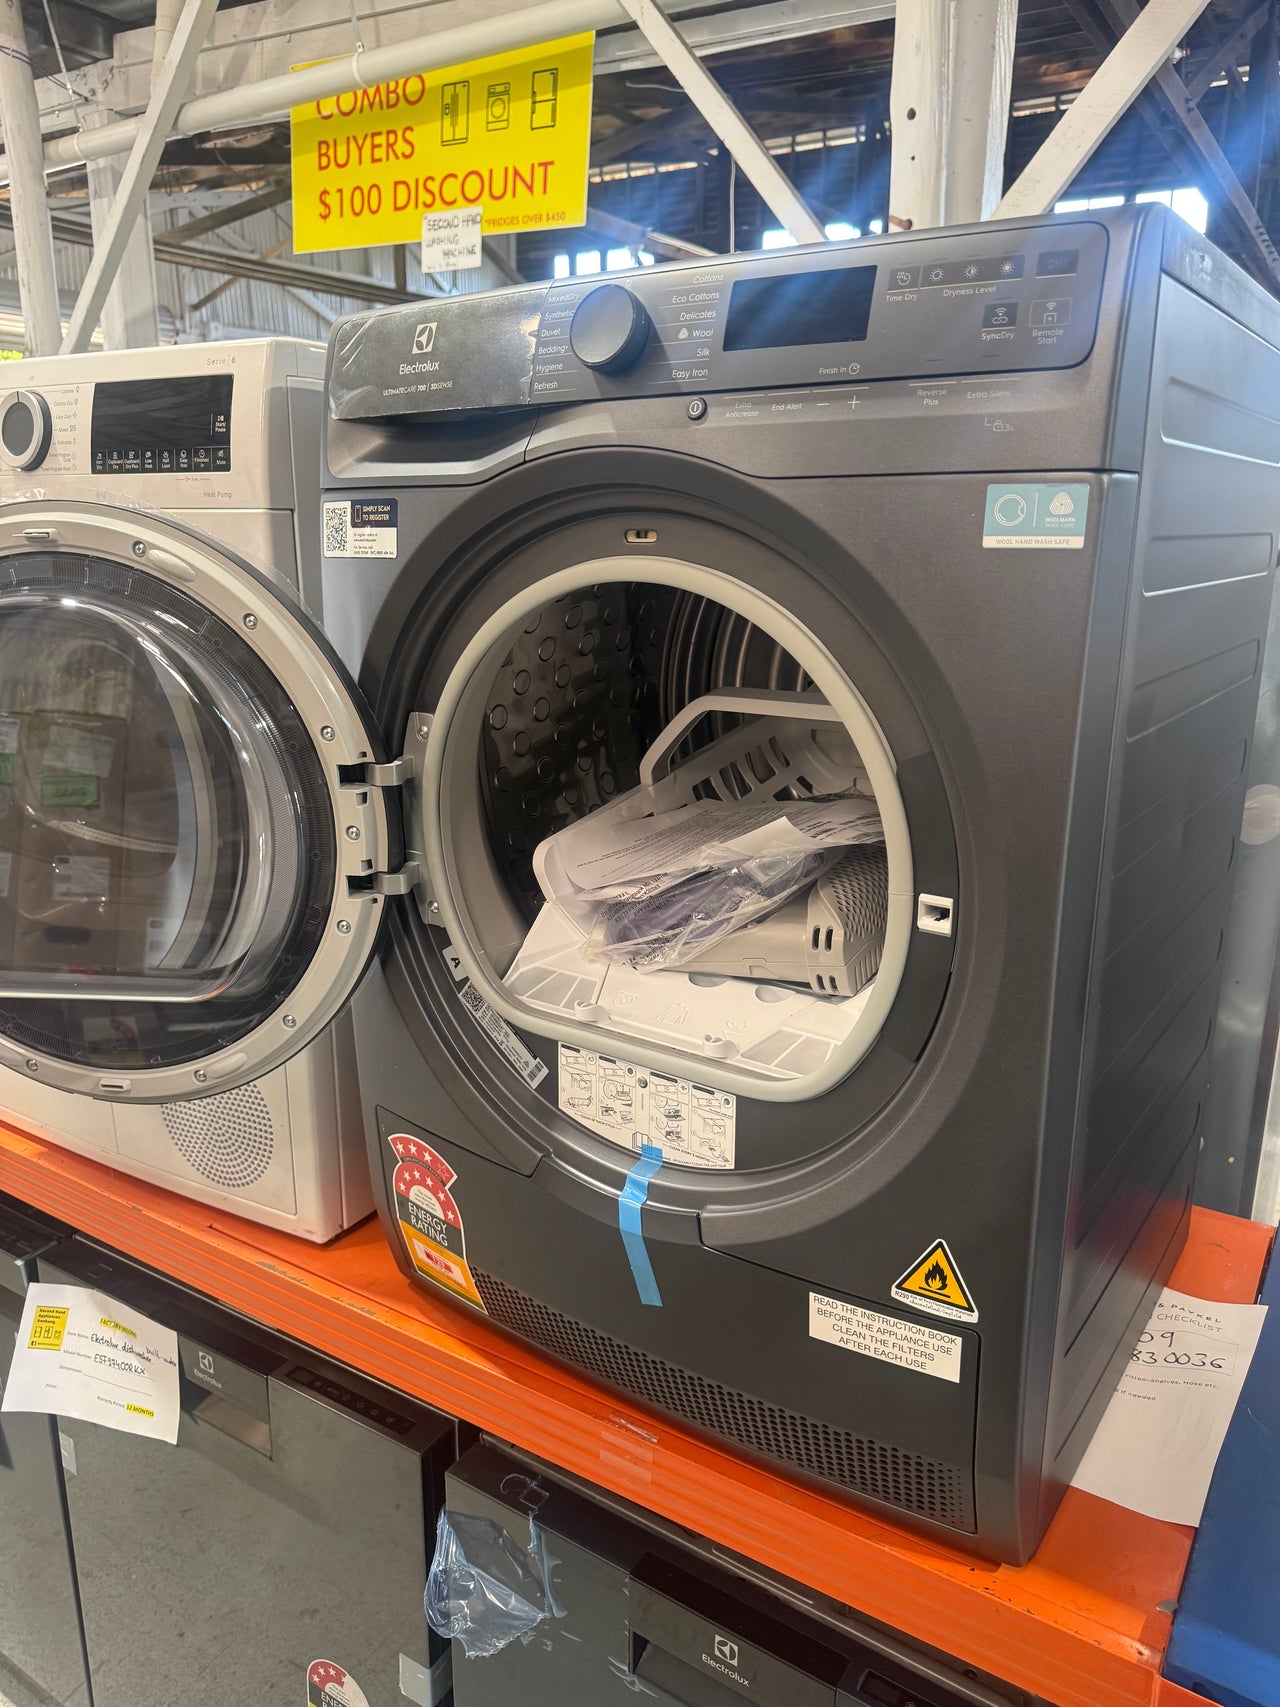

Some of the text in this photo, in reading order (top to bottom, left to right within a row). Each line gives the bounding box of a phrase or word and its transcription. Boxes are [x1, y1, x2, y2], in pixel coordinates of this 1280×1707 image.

[316, 74, 426, 120] COMBO
[318, 126, 415, 171] BUYERS
[319, 161, 554, 223] $100 DISCOUNT
[693, 274, 723, 284] Cottons
[943, 286, 997, 297] Dryness Level
[672, 292, 720, 303] Eco Cottons
[886, 294, 903, 302] Time
[680, 311, 716, 320] Delicates
[541, 328, 561, 337] Duvet
[693, 329, 713, 337] Wool
[981, 331, 1016, 342] SyncDry
[1032, 328, 1064, 336] Remote
[1037, 336, 1057, 345] Start
[696, 348, 710, 357] Silk
[399, 360, 439, 374] Electrolux
[536, 363, 563, 373] Hygiene
[819, 367, 838, 375] Finish
[672, 369, 708, 379] Easy Iron
[534, 381, 558, 389] Refresh
[918, 389, 947, 397] Reverse
[450, 957, 461, 969] A
[408, 1202, 447, 1234] ENERGY
[411, 1216, 448, 1247] RATING
[895, 1290, 909, 1299] R290
[1171, 1304, 1221, 1323] PAYKEL
[813, 1295, 958, 1346] READ THE INSTRUCTION BOOK
[1157, 1313, 1223, 1332] CHECKLIST
[817, 1308, 953, 1356] BEFORE THE APPLIANCE USE
[832, 1324, 935, 1361] CLEAN THE FILTERS
[838, 1336, 928, 1370] AFTER EACH USE
[193, 1368, 222, 1389] Electrolux
[132, 1406, 154, 1417] MONTHS
[702, 1653, 750, 1688] Electrolux
